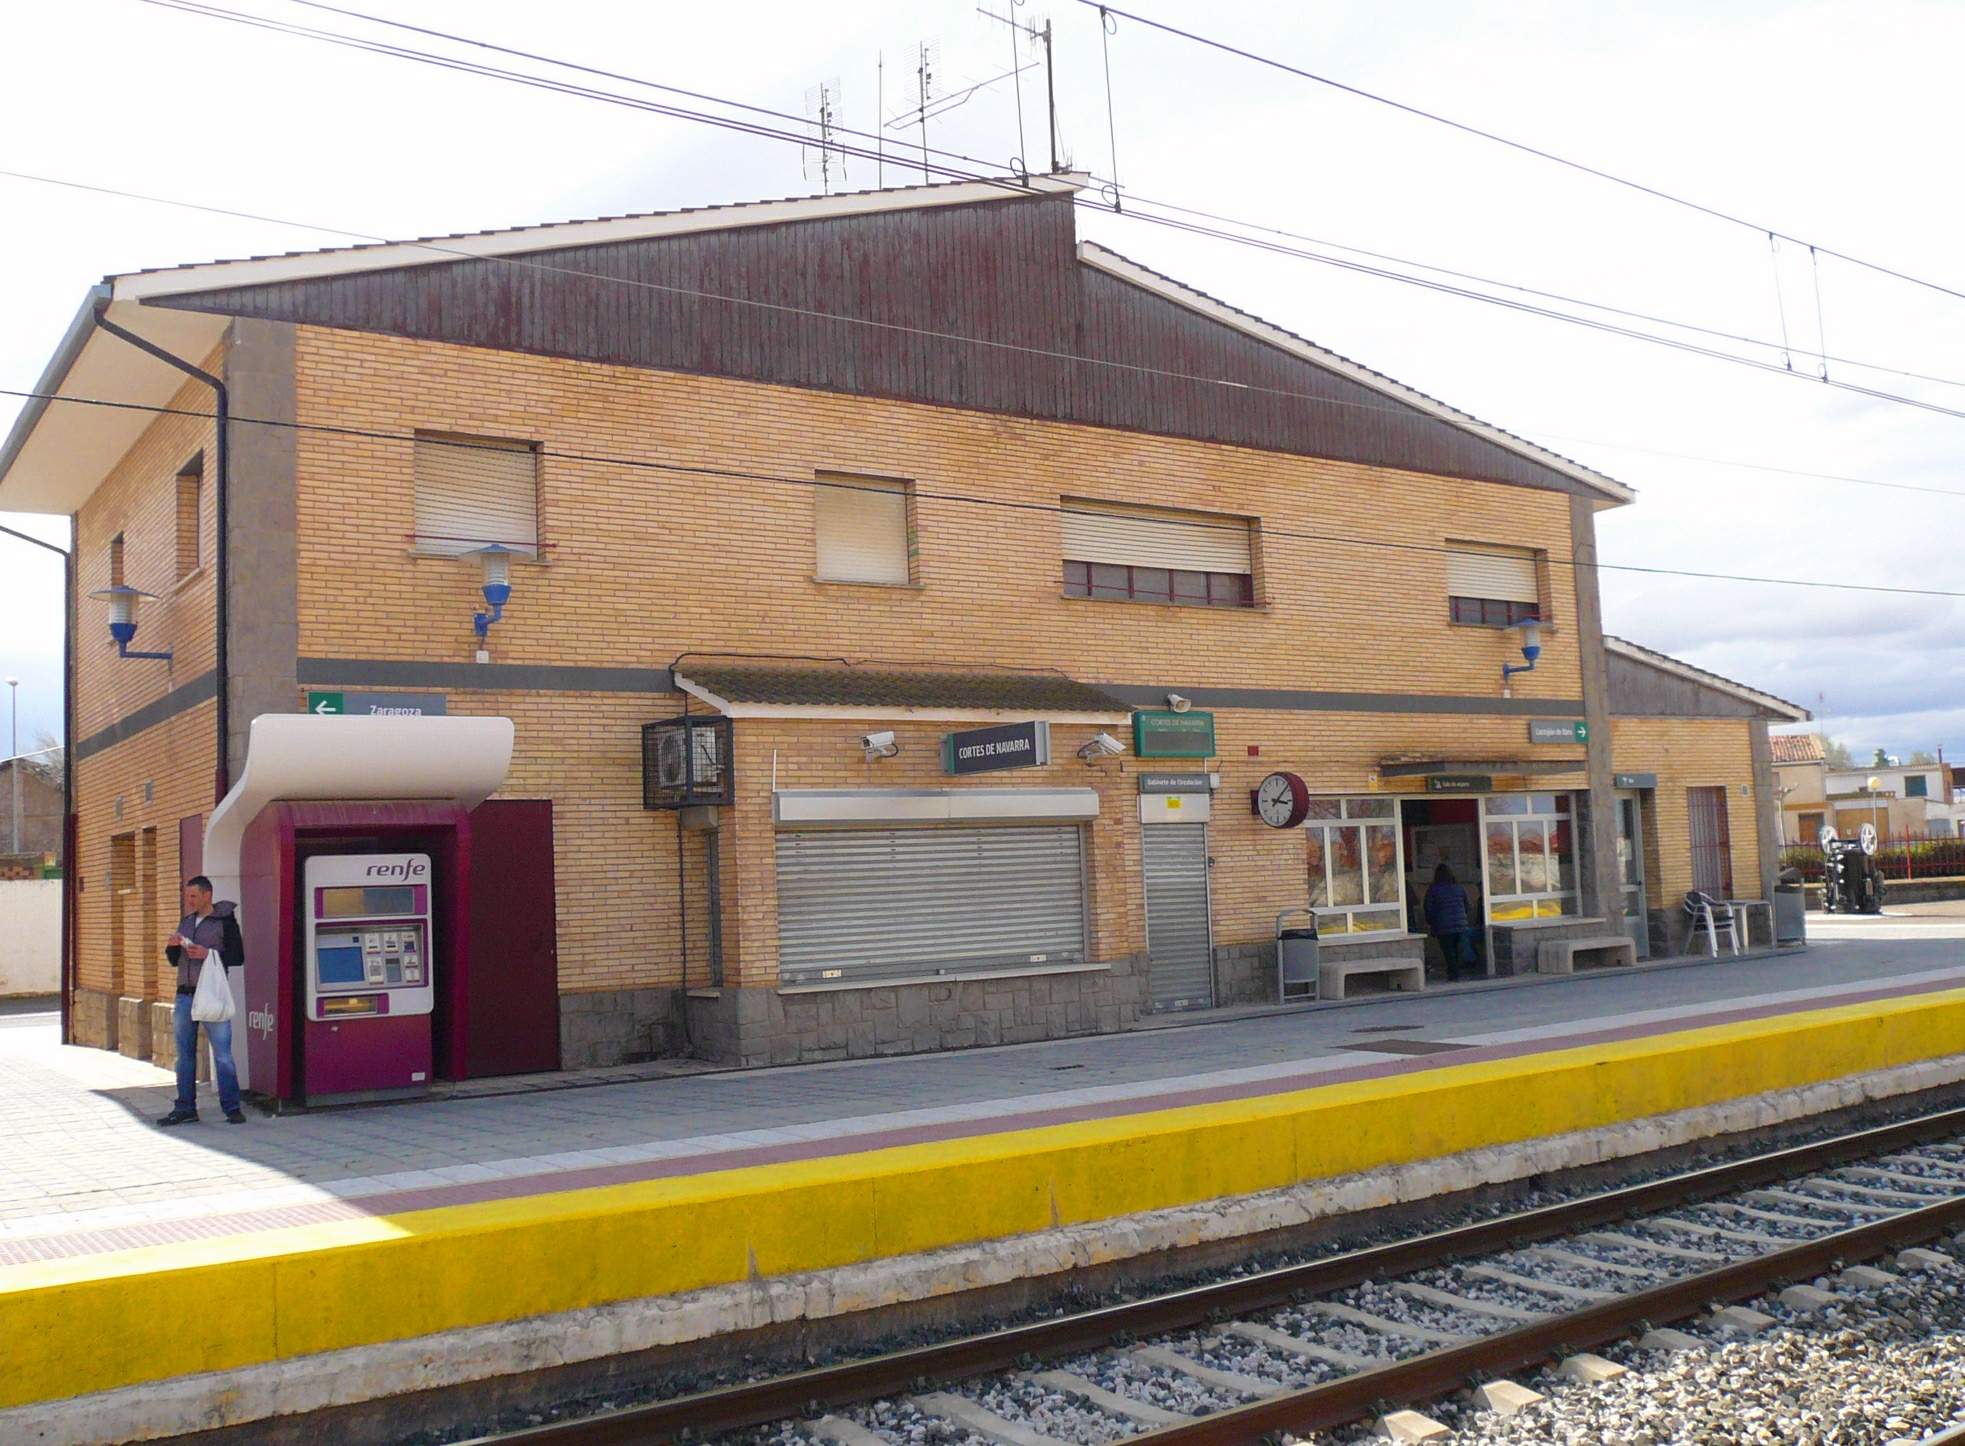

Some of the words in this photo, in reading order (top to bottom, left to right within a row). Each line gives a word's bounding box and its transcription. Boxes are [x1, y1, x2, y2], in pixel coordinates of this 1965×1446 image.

[369, 704, 422, 715] Zaragoza
[959, 744, 985, 759] CORTES
[985, 743, 996, 756] DE
[996, 738, 1030, 754] NAVARRA
[366, 858, 426, 882] renfe
[249, 1003, 273, 1040] renfe
